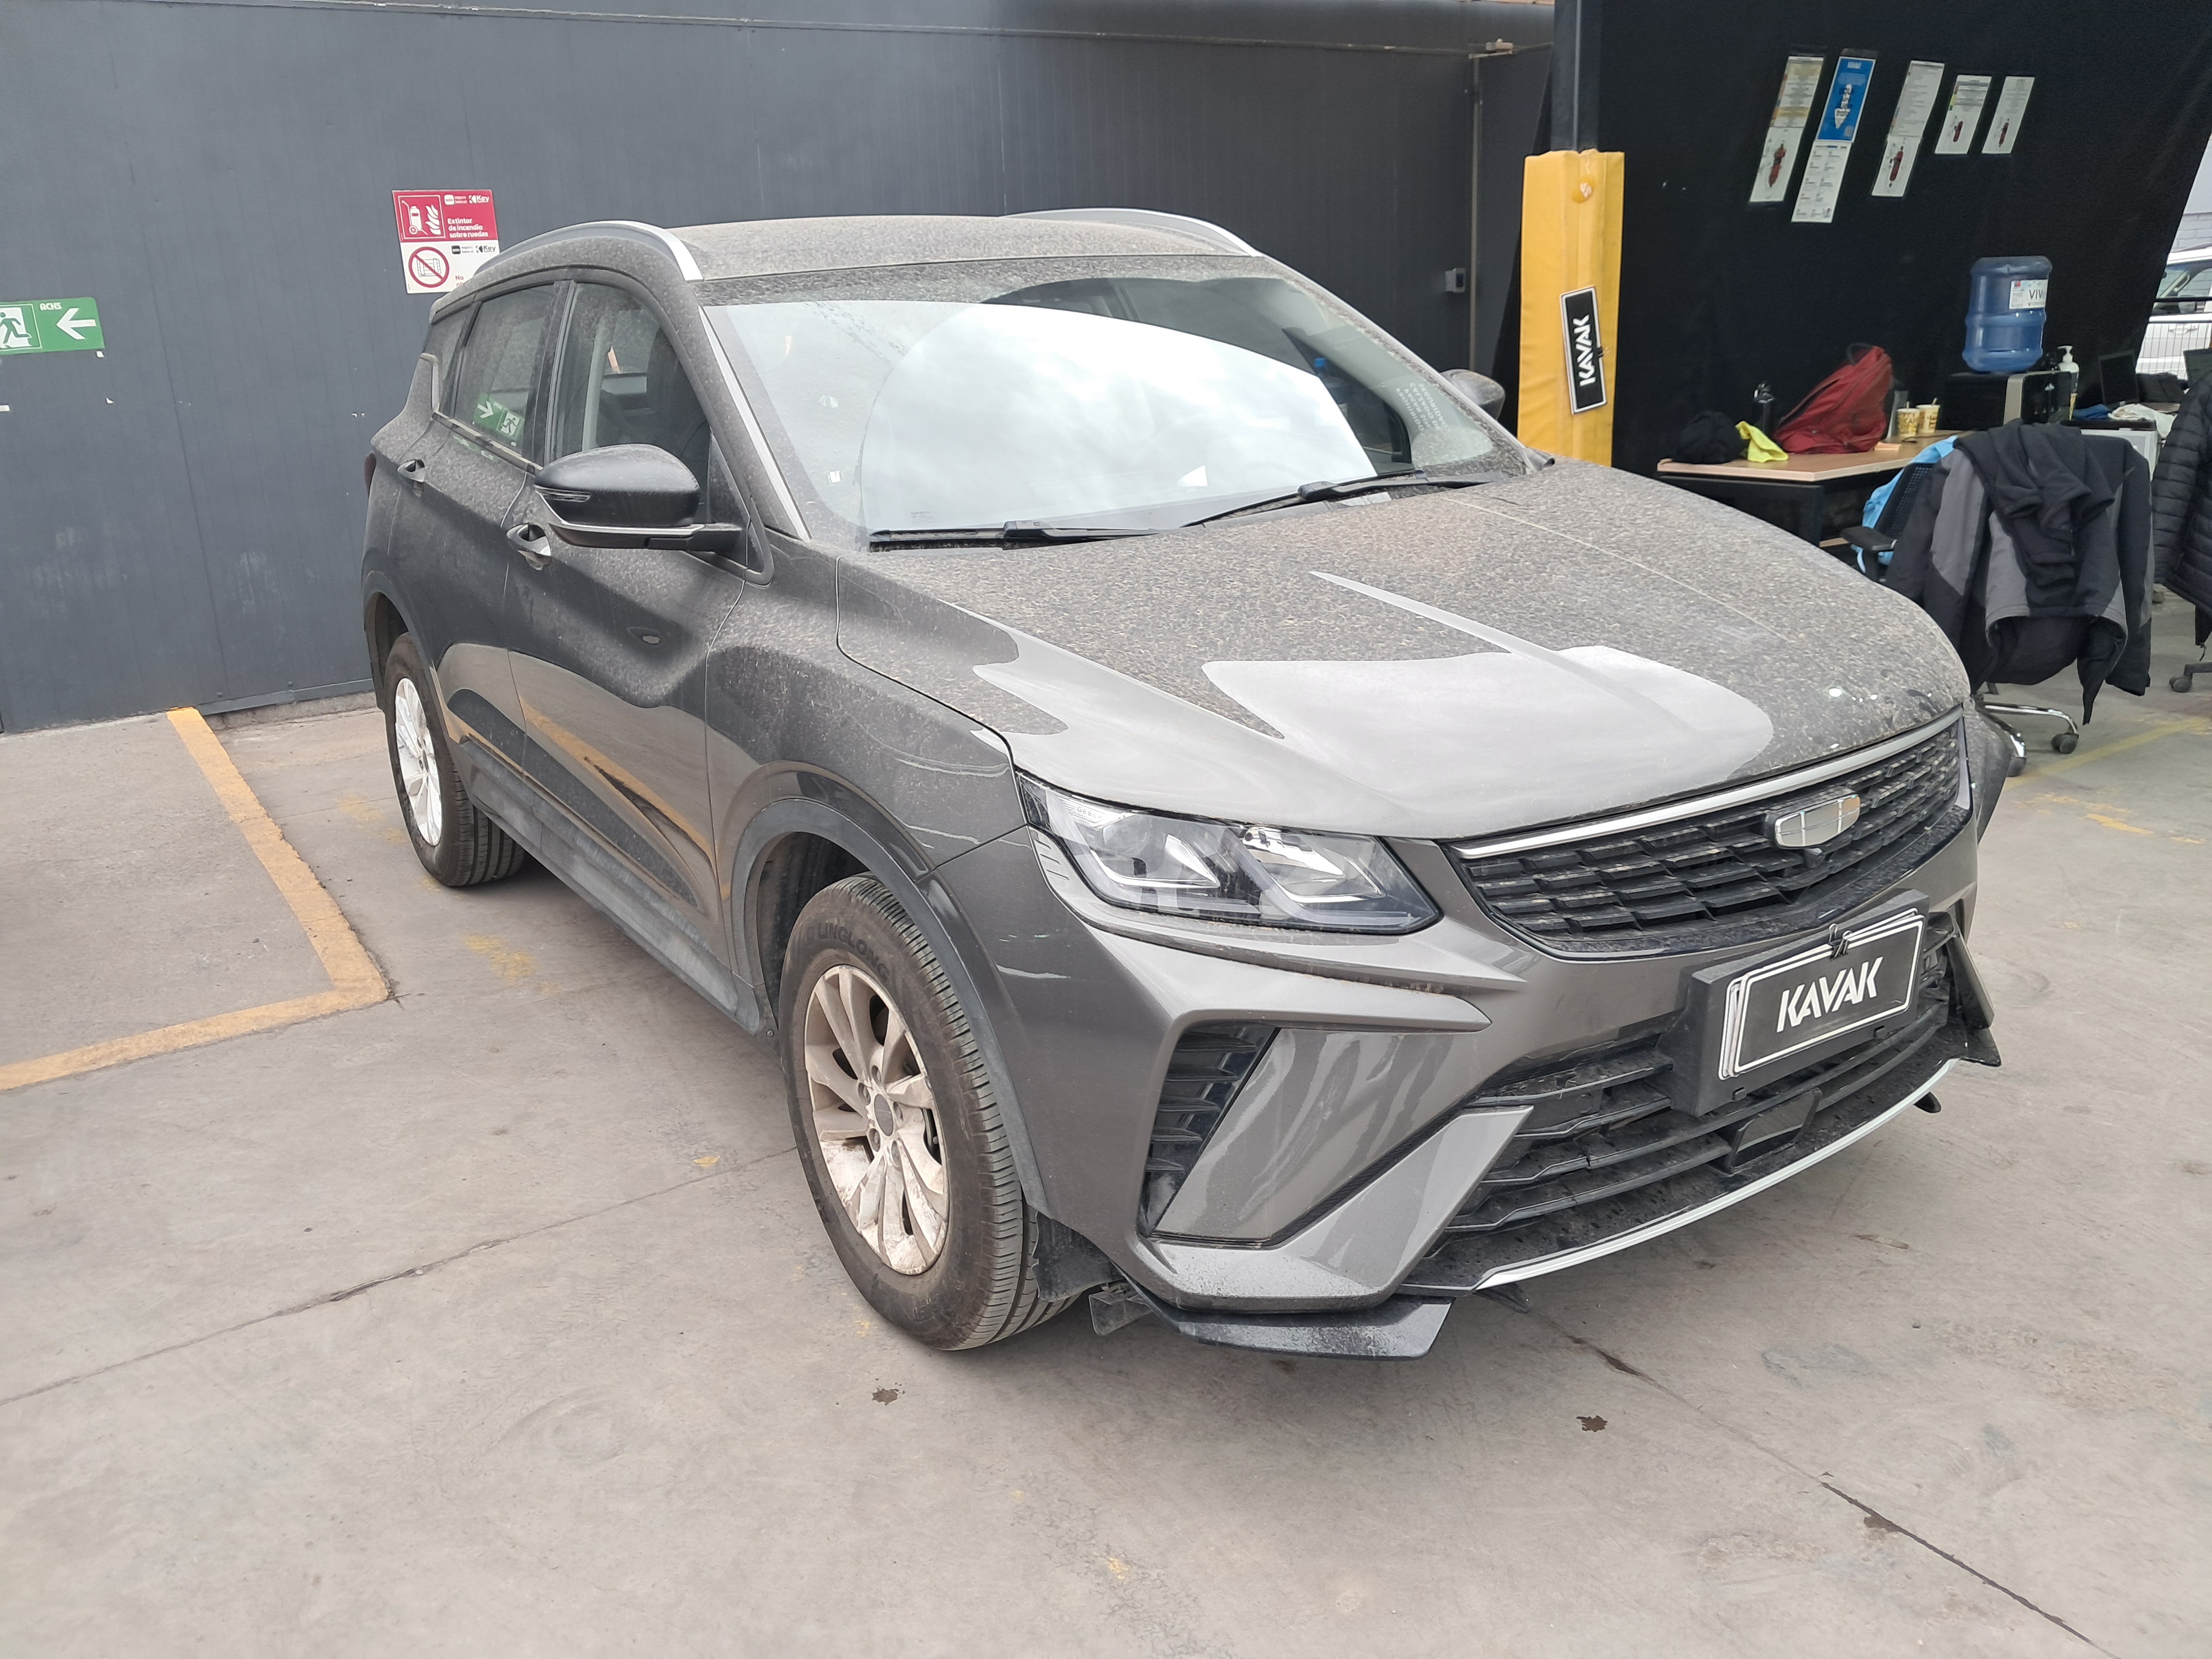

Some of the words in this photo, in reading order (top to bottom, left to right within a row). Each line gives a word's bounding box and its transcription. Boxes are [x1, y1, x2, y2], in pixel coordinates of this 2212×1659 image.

[40, 302, 62, 311] ACHS
[1573, 314, 1597, 387] KAVAK
[1077, 806, 1103, 819] GEELY
[818, 922, 890, 982] LINGLONG
[1776, 956, 1885, 1033] KAVAK
